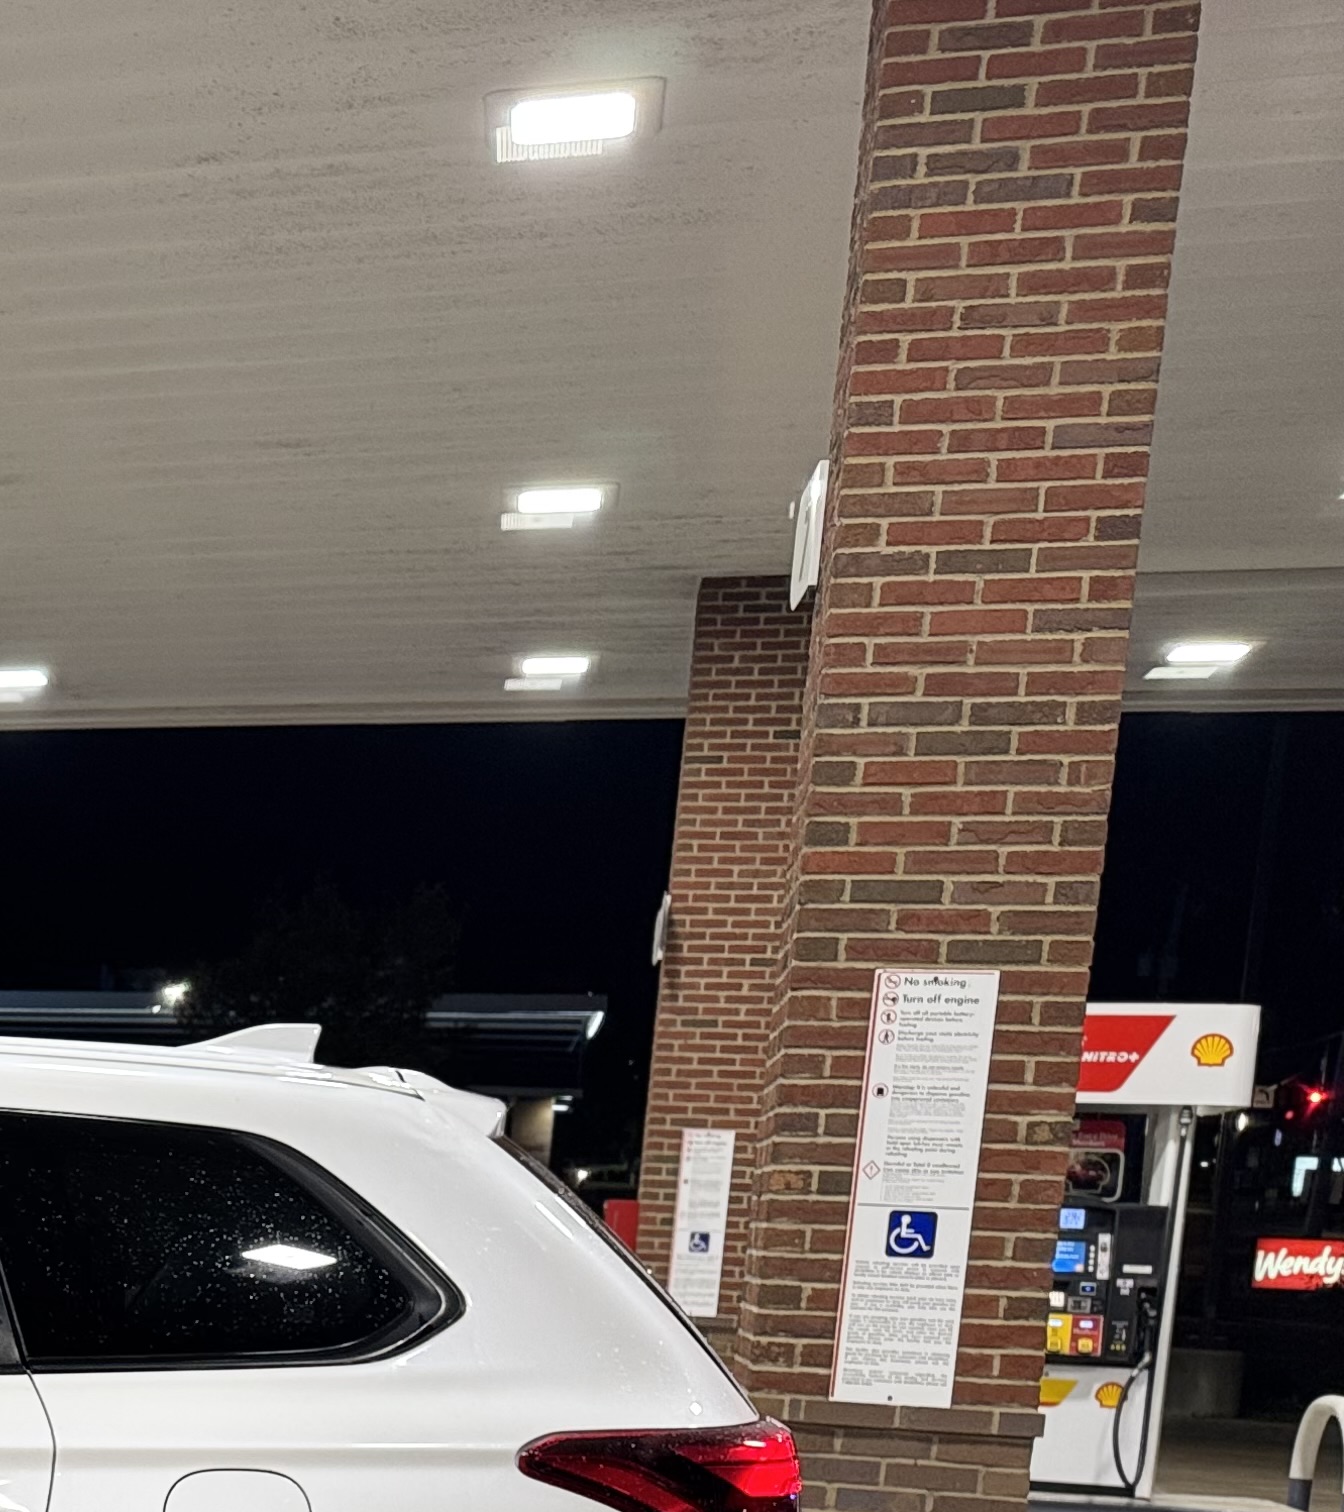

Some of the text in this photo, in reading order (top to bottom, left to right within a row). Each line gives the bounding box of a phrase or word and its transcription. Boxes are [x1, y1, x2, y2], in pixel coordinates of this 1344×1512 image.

[903, 976, 967, 989] No smoking
[903, 993, 980, 1006] Turn off engine
[1254, 1245, 1344, 1284] Wendy
